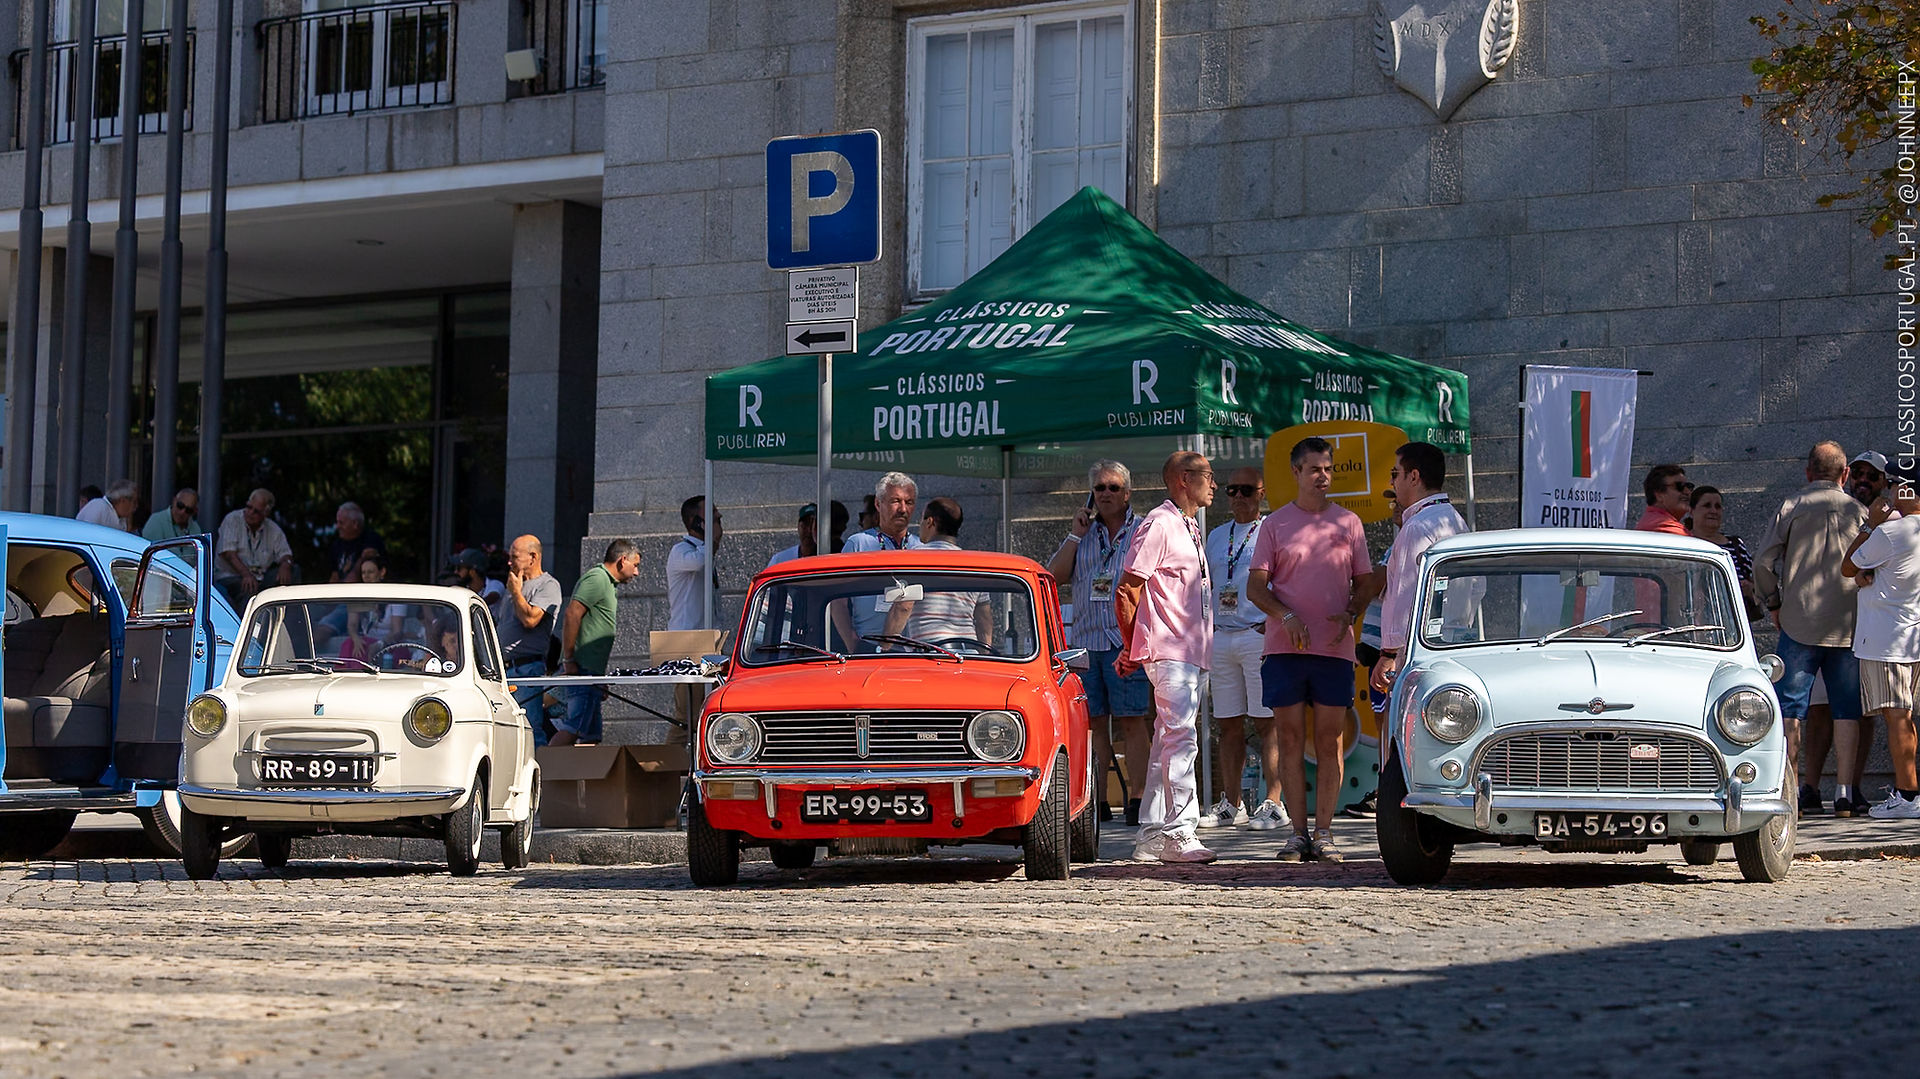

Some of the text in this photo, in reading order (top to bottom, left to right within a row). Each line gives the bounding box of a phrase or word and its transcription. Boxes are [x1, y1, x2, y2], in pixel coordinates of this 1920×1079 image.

[791, 151, 855, 253] P
[790, 293, 855, 303] VIATURAS AUTORIZADAS
[934, 302, 1070, 323] CLÁSSICOS
[868, 323, 1075, 356] PORTUGAL
[897, 373, 985, 396] CLÁSSICOS
[1132, 359, 1160, 405] R
[1221, 359, 1239, 405] R
[1315, 370, 1363, 394] CLÁSSICOS
[739, 385, 763, 427] R
[1437, 381, 1453, 423] R
[873, 400, 1006, 441] PORTUGAL
[1108, 409, 1185, 428] PUBLIREN
[1208, 409, 1253, 427] PUBLIREN
[717, 432, 786, 449] PUBLIREN
[1427, 427, 1465, 444] PUBLIREN
[1332, 459, 1362, 473] cola
[1554, 488, 1602, 503] CLÁSSICOS
[1541, 505, 1614, 529] PORTUGAL
[265, 760, 369, 779] RR-89-11
[806, 795, 925, 816] ER-99-53
[1538, 814, 1666, 836] BA-54-96
